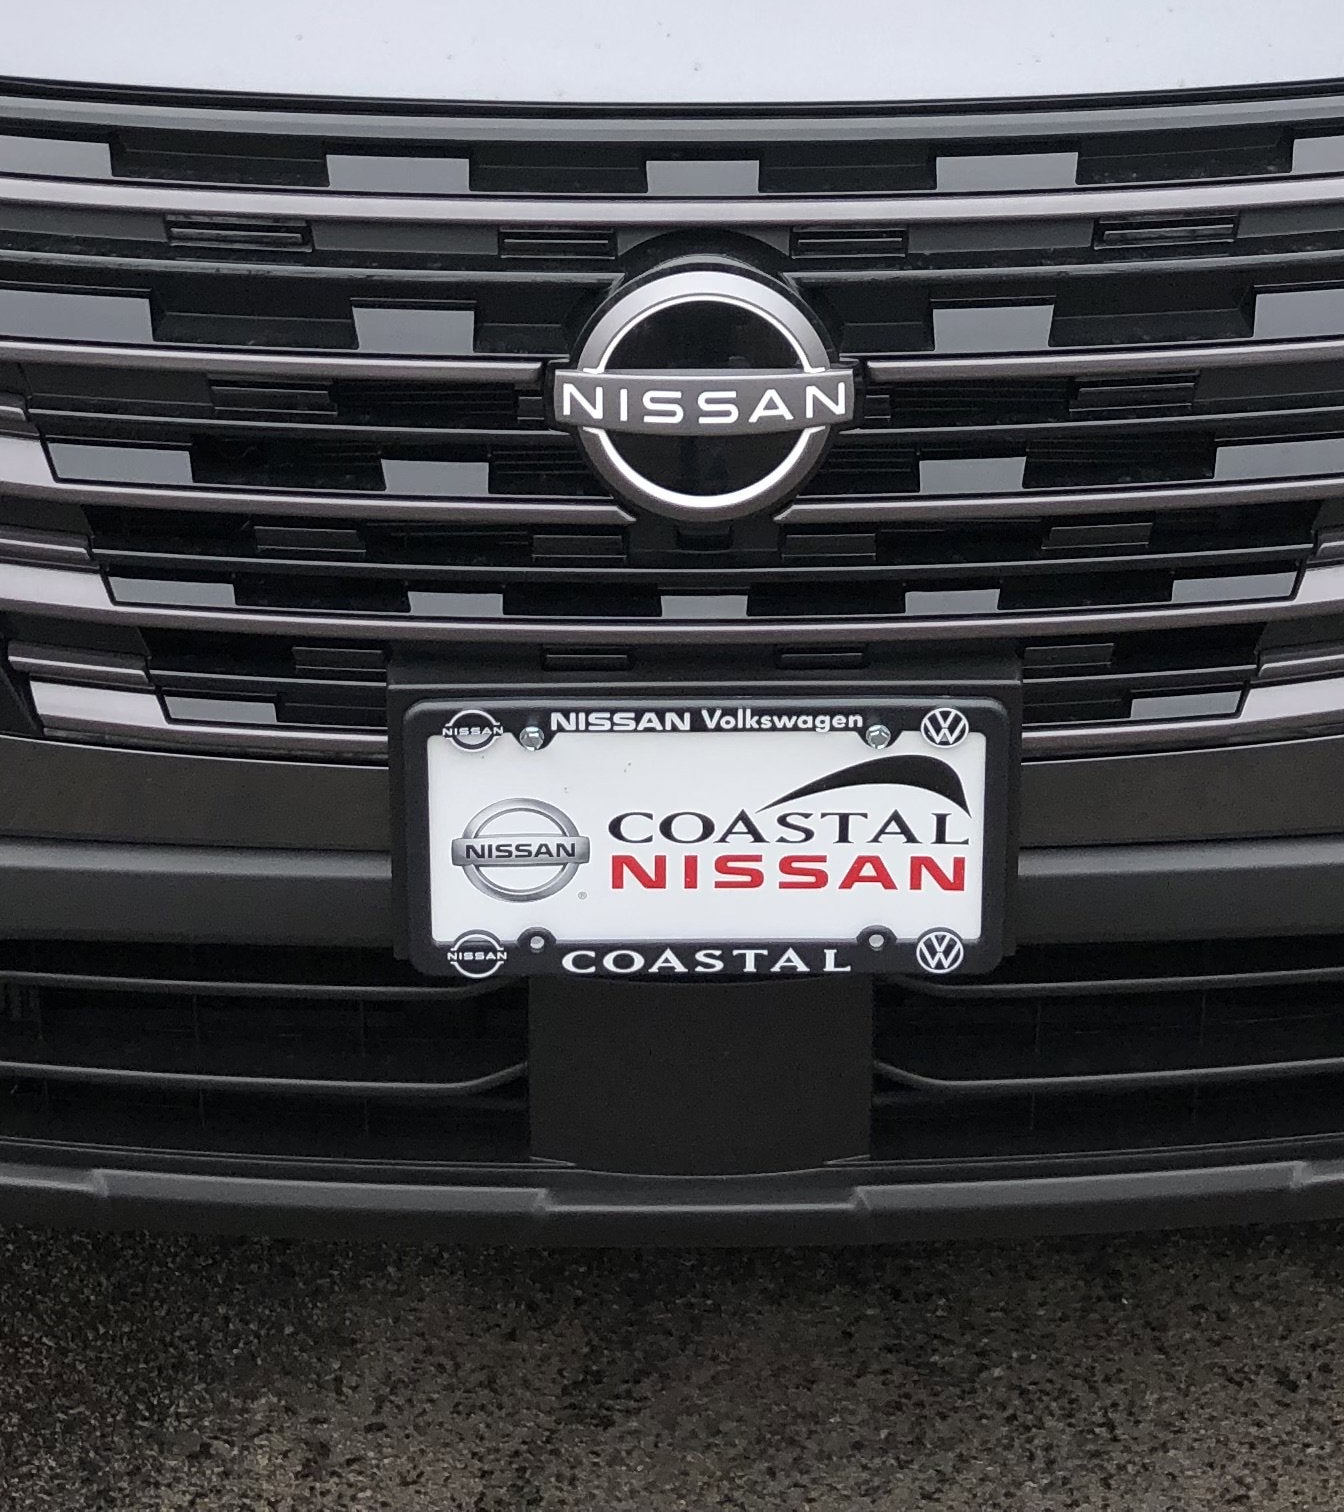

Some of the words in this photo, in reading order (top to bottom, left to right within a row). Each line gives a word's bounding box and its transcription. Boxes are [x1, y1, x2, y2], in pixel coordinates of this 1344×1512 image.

[563, 382, 846, 424] NISSAN
[442, 726, 504, 736] NISSAN
[550, 711, 691, 731] NISSAN
[701, 708, 863, 733] Volkswagen
[608, 808, 970, 846] COASTAL
[465, 843, 576, 859] NISSAN
[611, 854, 966, 892] NISSAN
[447, 951, 507, 961] NISSAN
[562, 948, 852, 974] COASTAL
